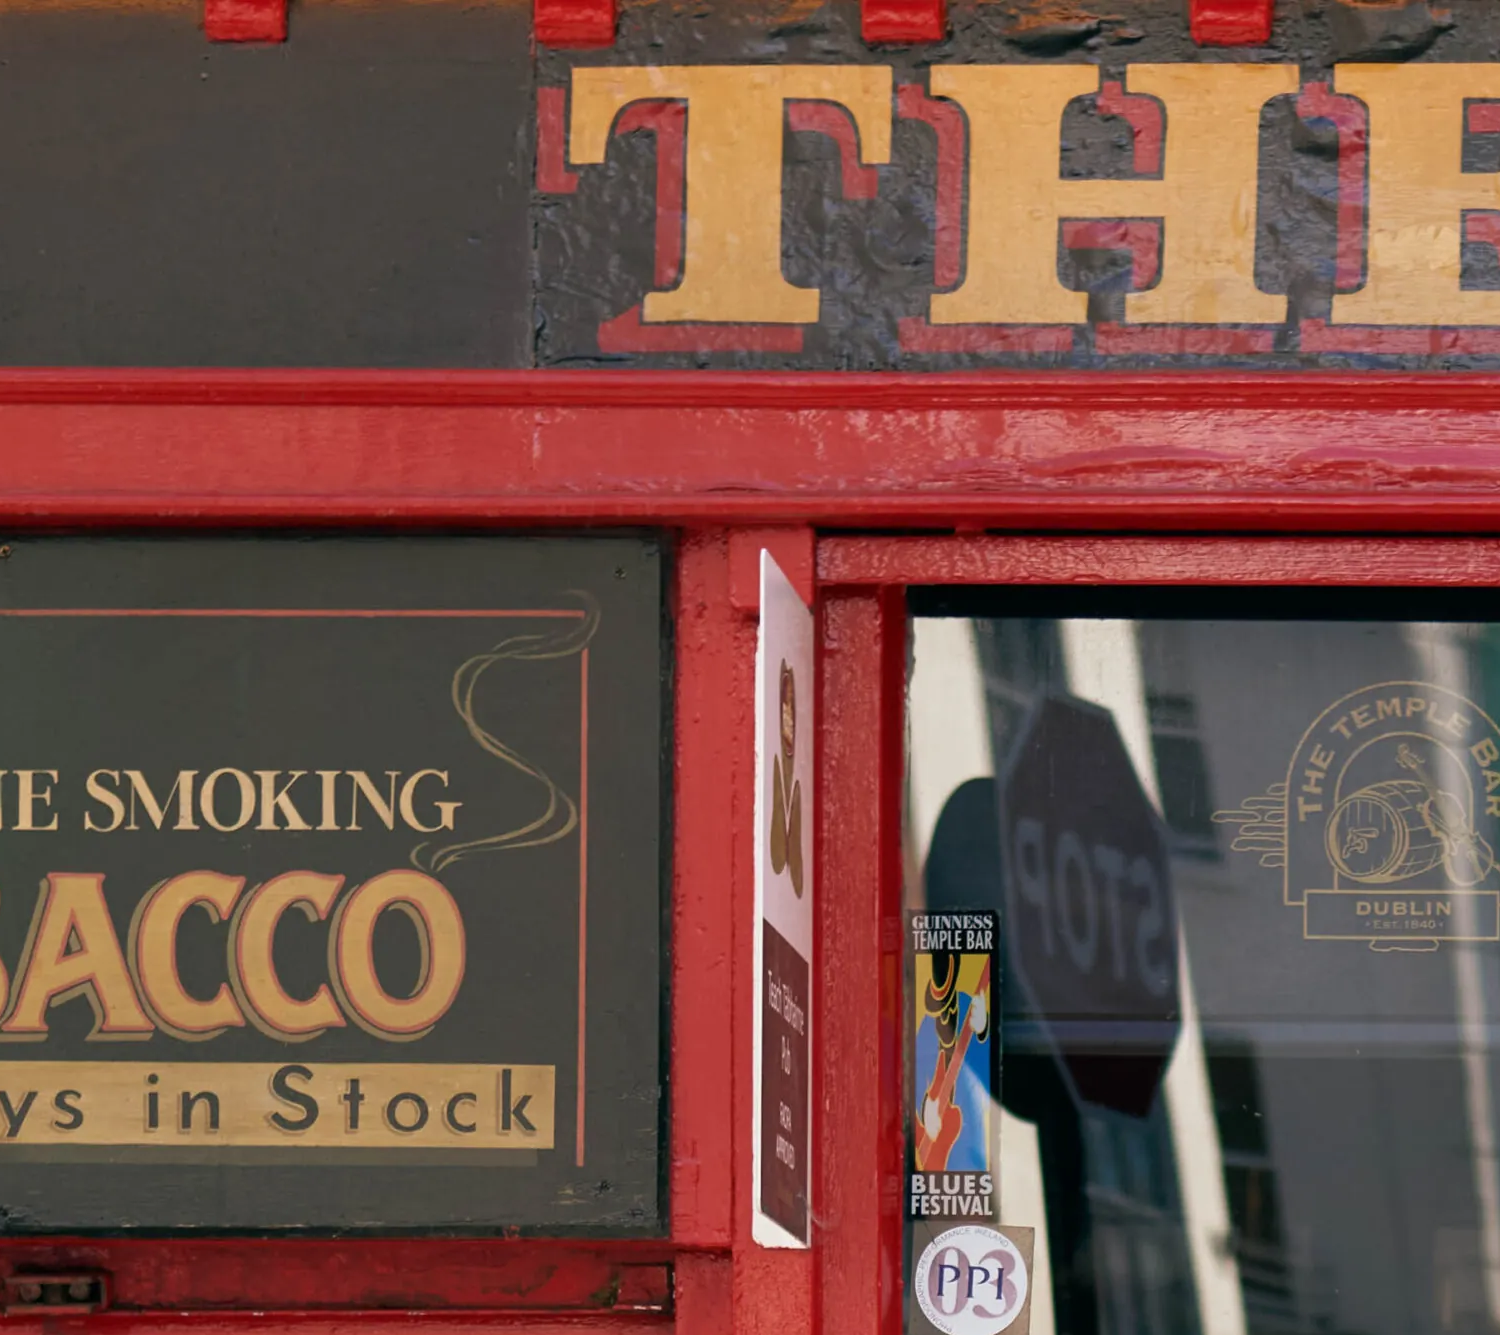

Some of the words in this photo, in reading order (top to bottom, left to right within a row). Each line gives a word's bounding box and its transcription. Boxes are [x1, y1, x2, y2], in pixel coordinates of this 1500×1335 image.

[1298, 743, 1335, 822] THE
[1330, 697, 1472, 738] TEMPLE
[84, 768, 463, 833] SMOKING
[1356, 901, 1451, 915] DUBLIN
[912, 915, 993, 929] GUINNESS
[912, 931, 963, 950] TEMPLE
[967, 931, 993, 950] BAR
[145, 1071, 220, 1134] in
[266, 1065, 541, 1136] Stock
[911, 1173, 993, 1194] BLUES
[911, 1195, 993, 1216] FESTIVAL
[937, 1265, 1004, 1300] PPI
